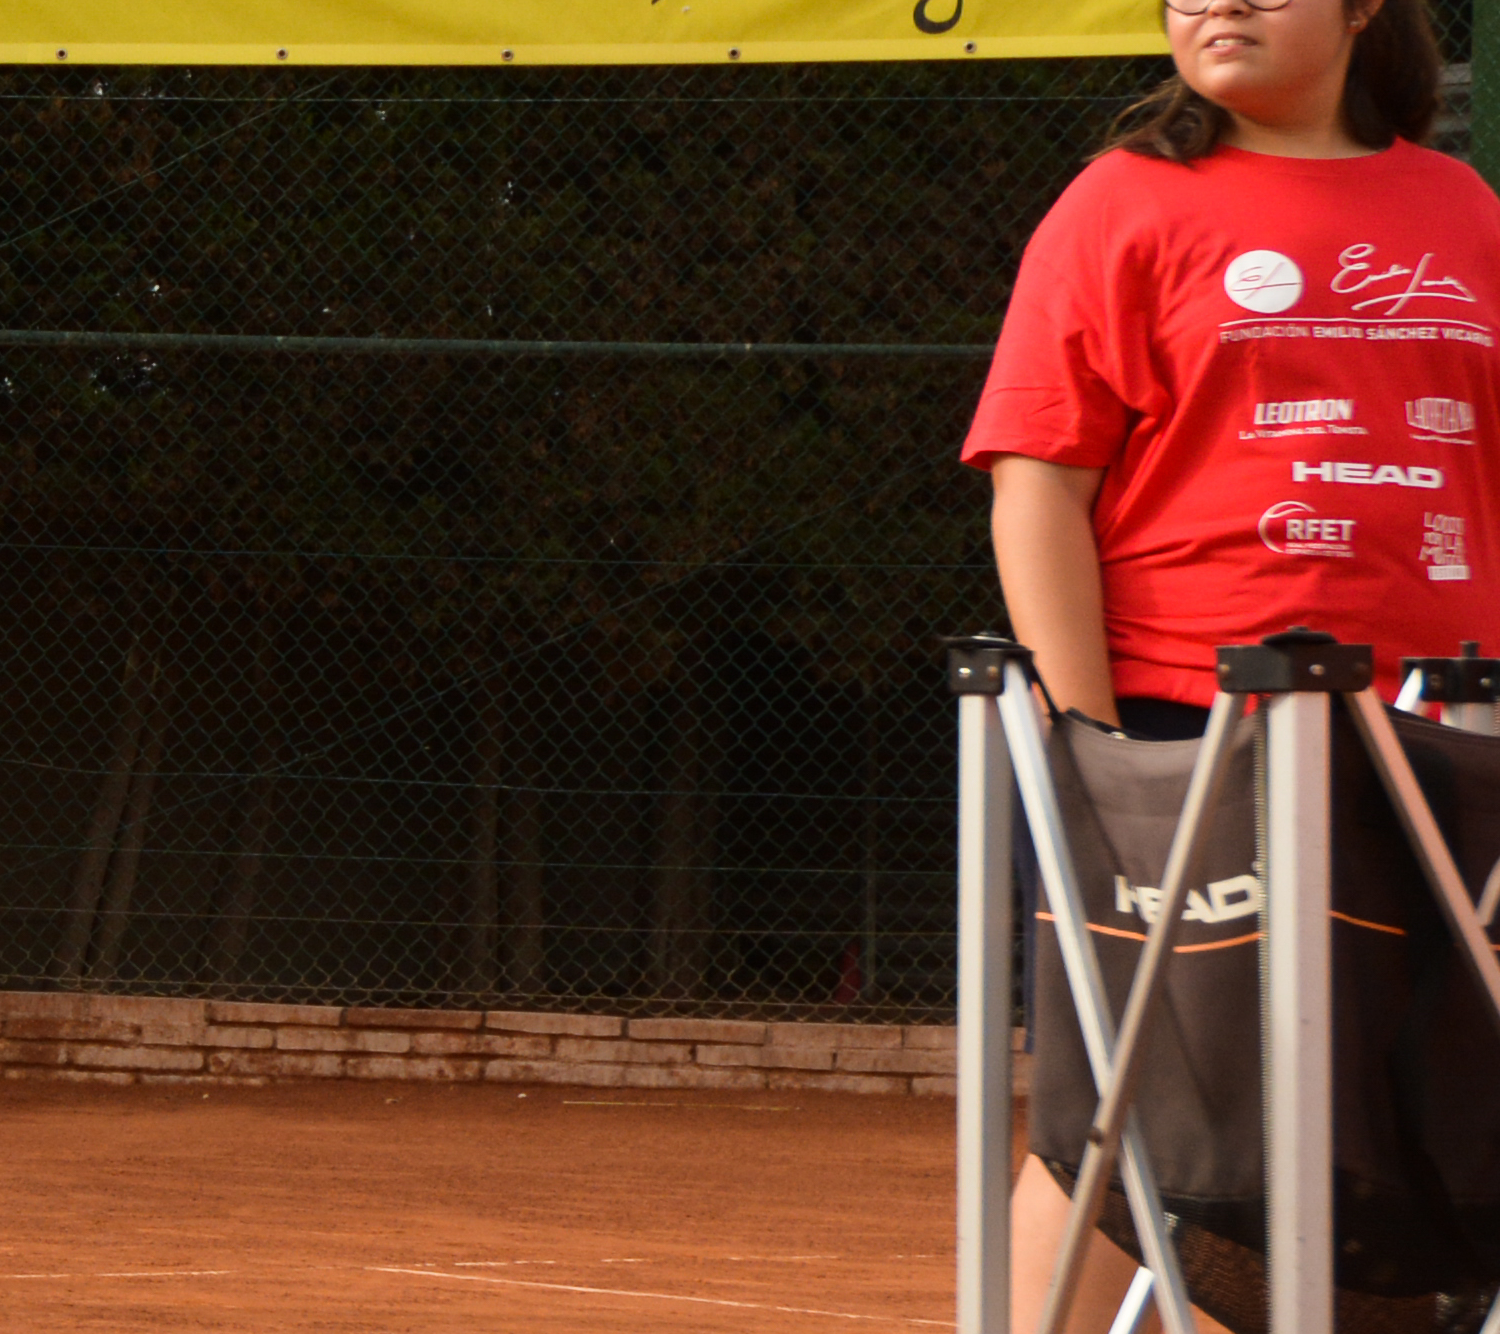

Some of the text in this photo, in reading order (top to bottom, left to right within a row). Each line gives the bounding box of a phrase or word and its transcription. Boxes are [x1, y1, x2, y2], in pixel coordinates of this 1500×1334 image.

[1253, 399, 1355, 425] LEOTRON
[1291, 461, 1445, 489] HEAD
[1285, 518, 1357, 542] RFET
[1113, 873, 1267, 925] HEAD
